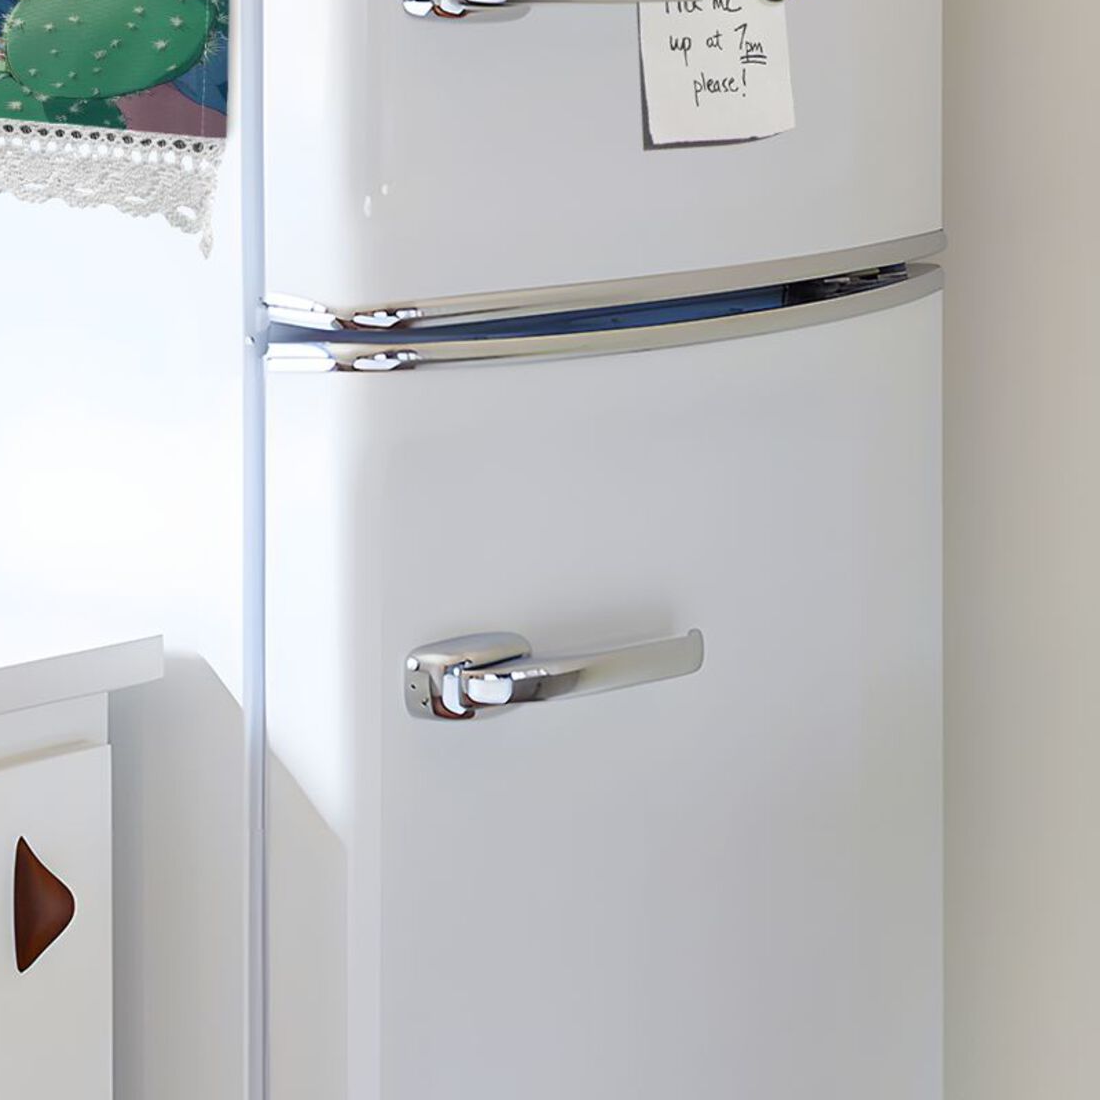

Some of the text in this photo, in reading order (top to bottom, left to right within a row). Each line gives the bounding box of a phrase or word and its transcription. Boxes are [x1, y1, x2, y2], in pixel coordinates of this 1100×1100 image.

[669, 35, 692, 67] up
[706, 30, 723, 51] at
[693, 68, 747, 107] please!
